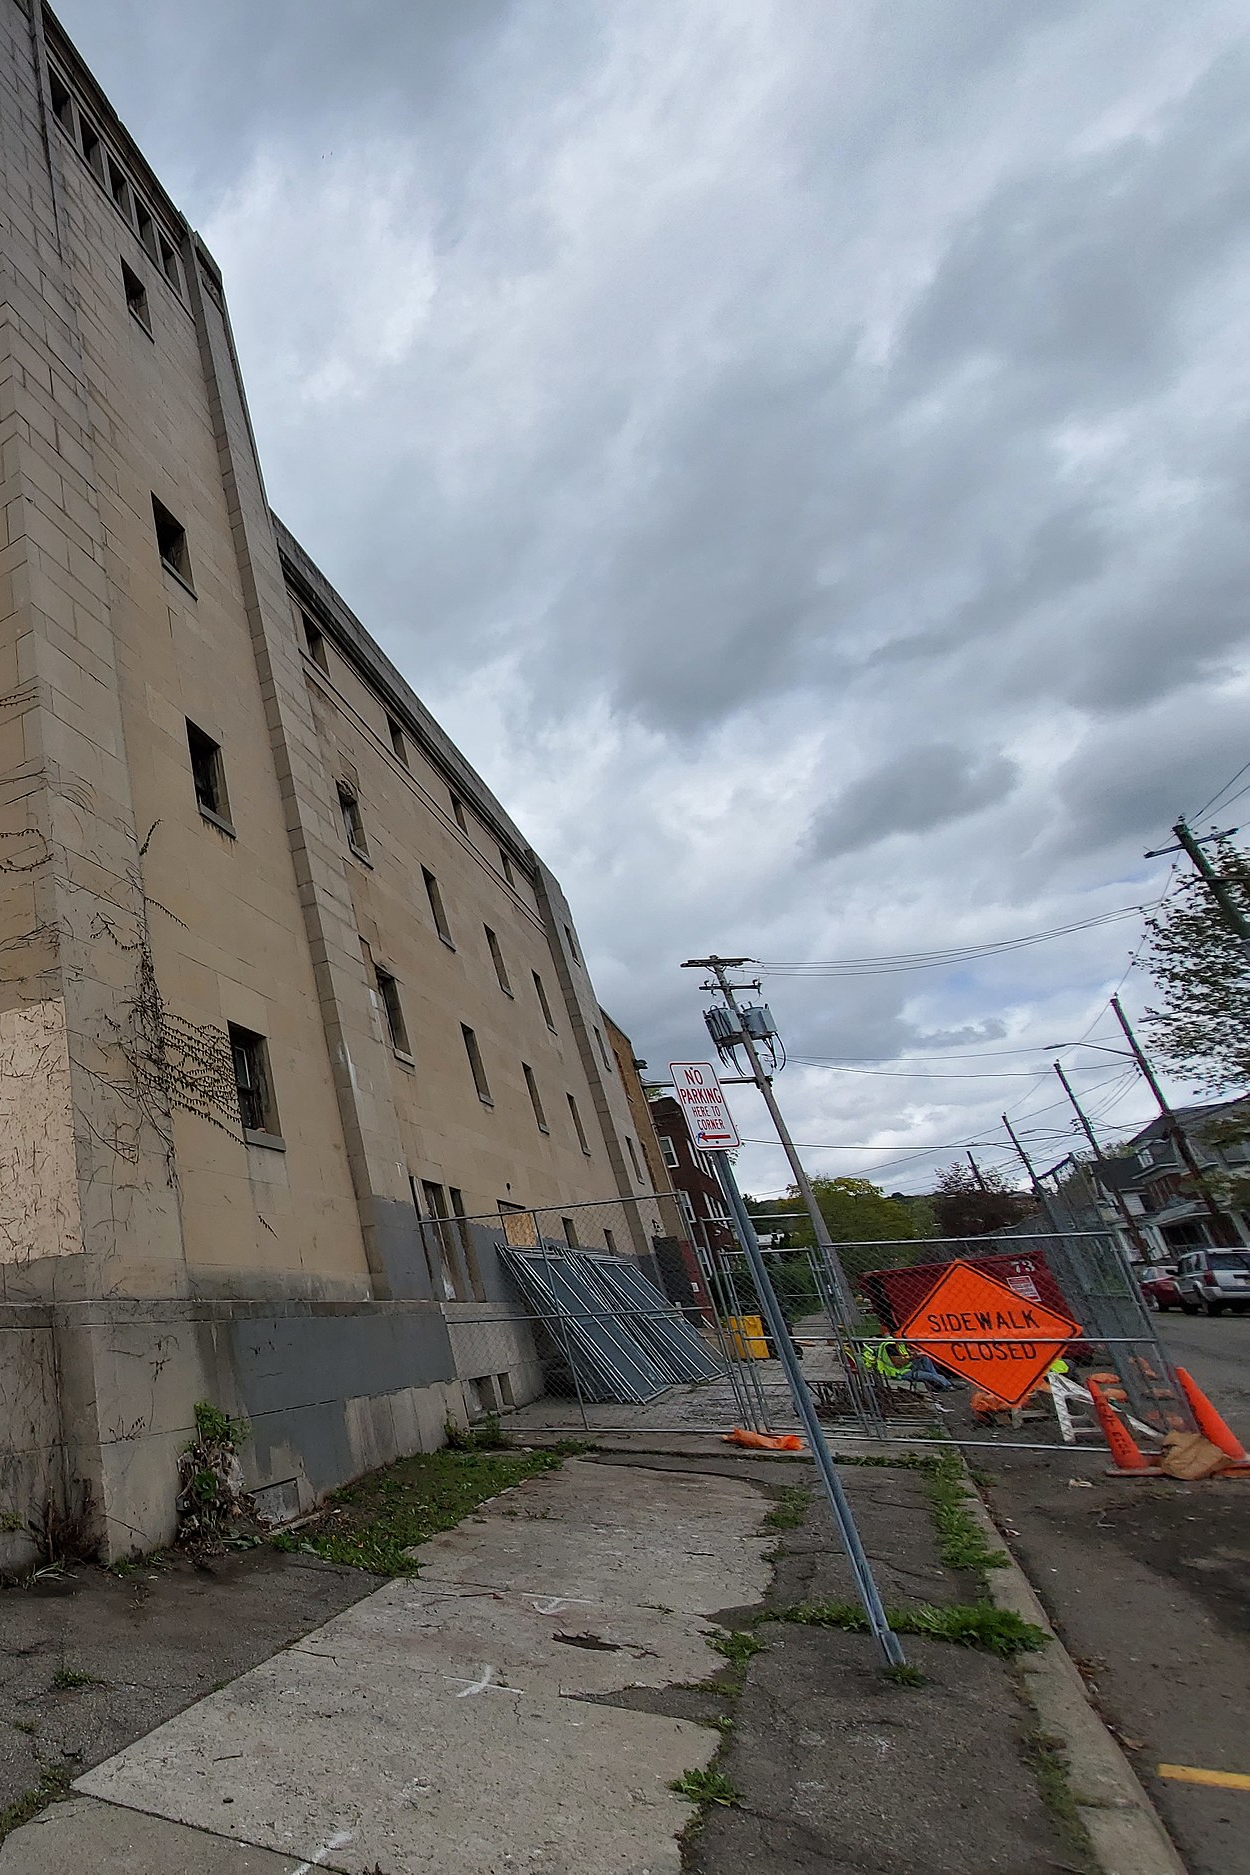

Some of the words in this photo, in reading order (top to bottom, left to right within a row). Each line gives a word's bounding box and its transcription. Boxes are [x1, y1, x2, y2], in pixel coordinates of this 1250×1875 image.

[684, 1069, 703, 1085] NO
[680, 1088, 722, 1104] PARKING
[692, 1106, 710, 1117] HERE
[711, 1105, 720, 1116] TO
[697, 1119, 725, 1130] CORNER
[1011, 1260, 1036, 1273] 73
[927, 1310, 1040, 1332] SIDEWALK
[951, 1342, 1037, 1361] CLOSED
